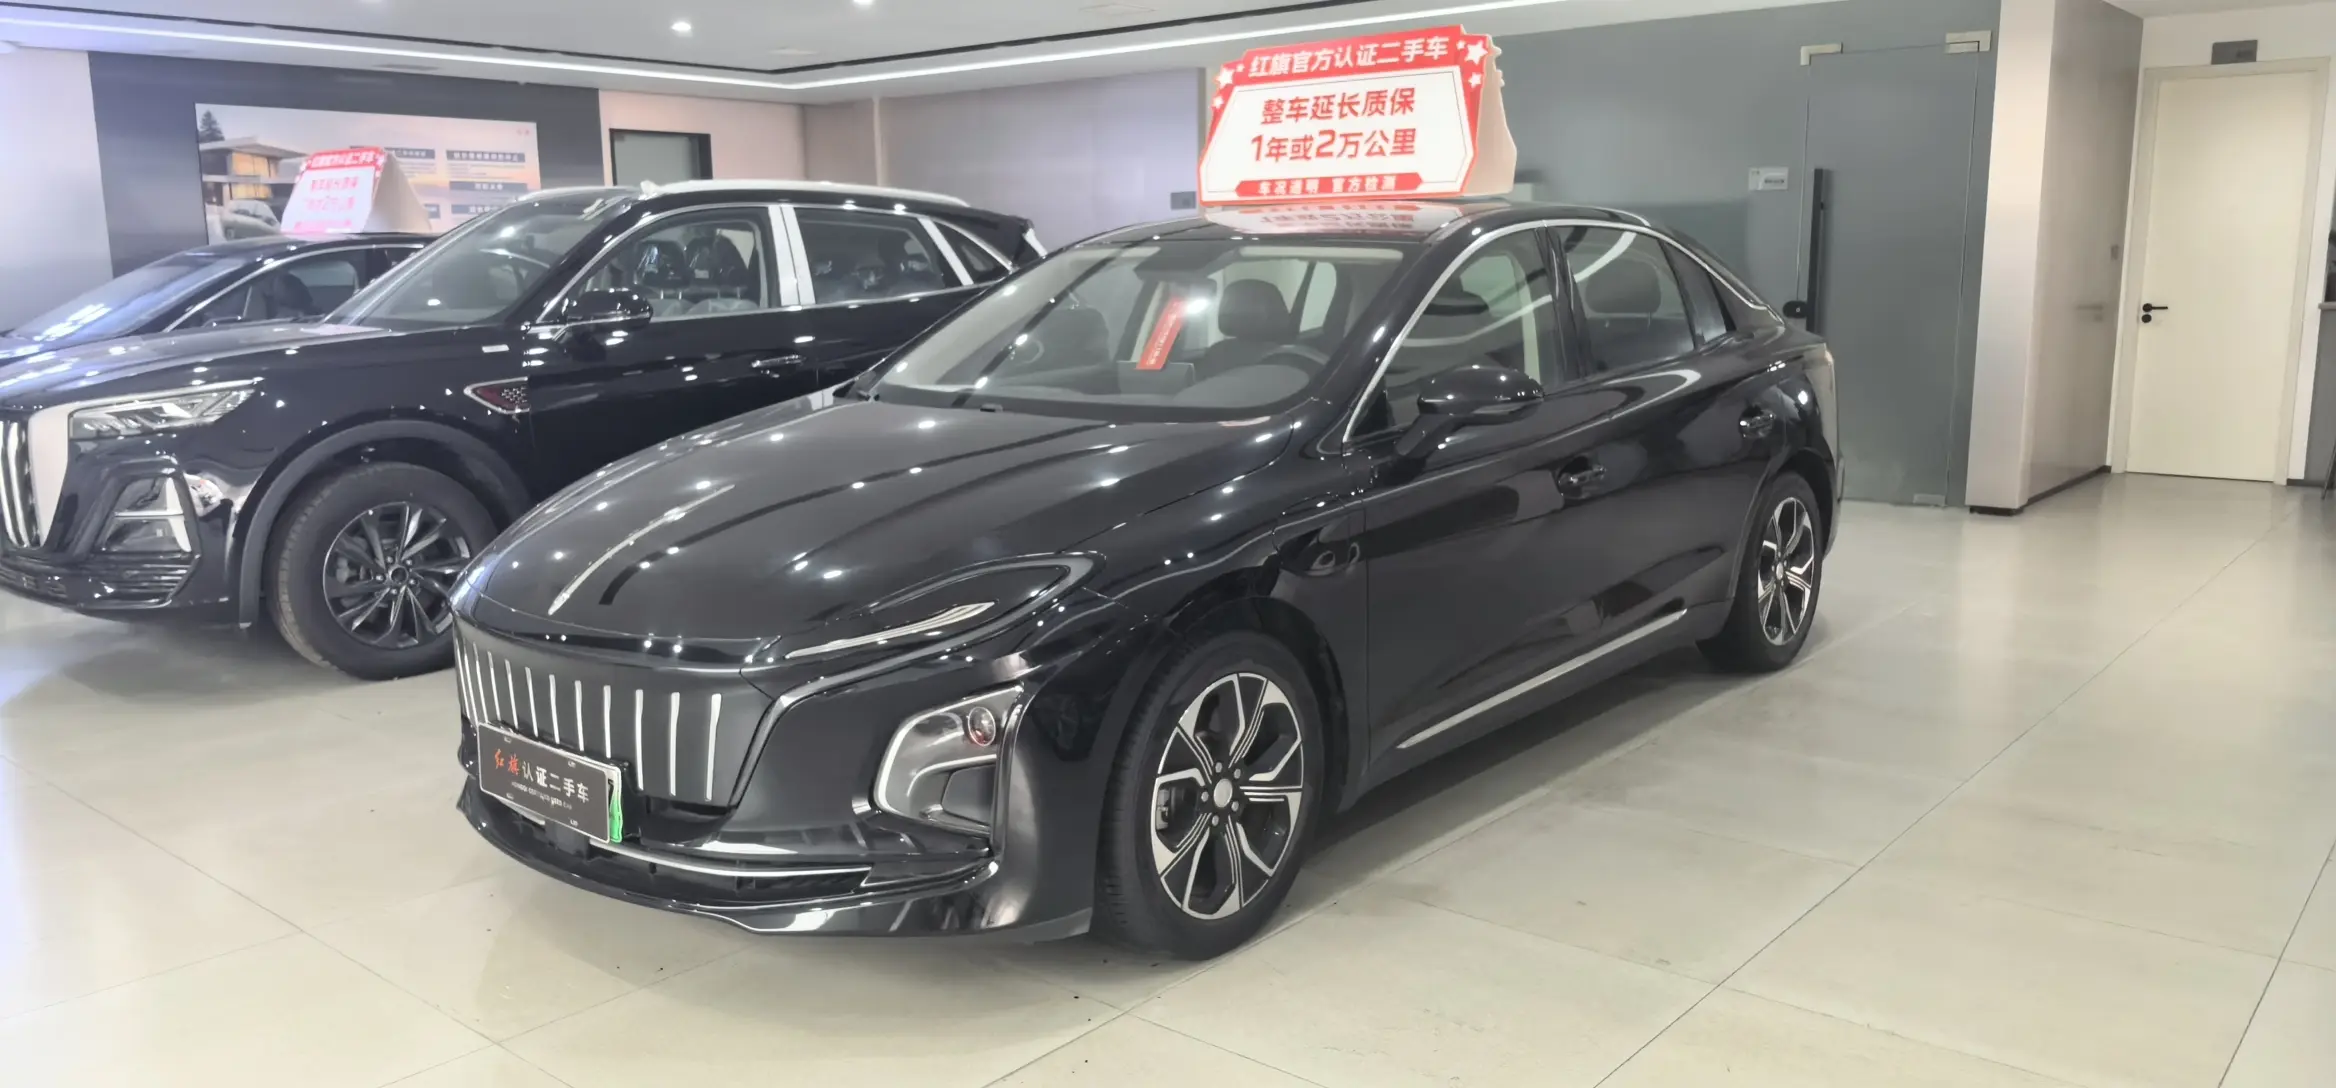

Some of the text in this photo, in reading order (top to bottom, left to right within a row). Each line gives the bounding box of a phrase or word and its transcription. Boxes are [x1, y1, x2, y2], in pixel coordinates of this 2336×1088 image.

[1248, 37, 1449, 78] 红旗官方认证二手车
[1261, 88, 1415, 125] 整车延长质保
[1251, 129, 1416, 162] 1年或2万公里
